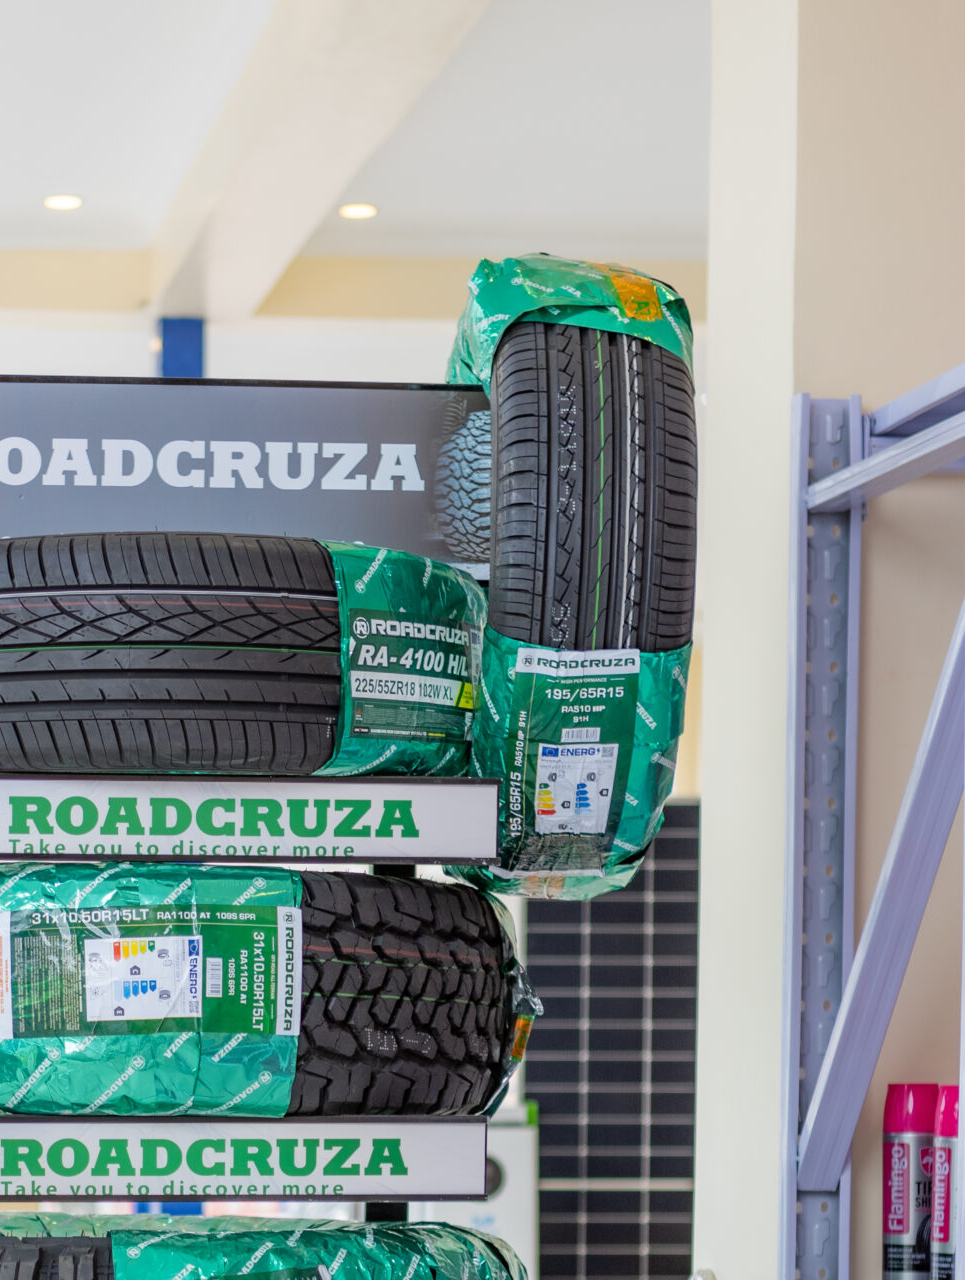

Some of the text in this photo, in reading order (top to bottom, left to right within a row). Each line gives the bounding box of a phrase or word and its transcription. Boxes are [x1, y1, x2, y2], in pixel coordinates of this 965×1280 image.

[371, 618, 469, 646] ROADCRUZA
[537, 657, 636, 669] ROADCRUZA
[355, 678, 416, 697] 225/55ZR18
[419, 682, 442, 699] 102W
[443, 684, 454, 700] XL
[545, 686, 625, 702] 195/65R15
[519, 711, 527, 727] 91H
[561, 705, 591, 713] RA510
[573, 715, 589, 723] 91H
[515, 741, 524, 767] RA510
[560, 747, 596, 757] ENERG
[8, 795, 420, 838] ROADCRUZA
[510, 771, 524, 838] 195/65R15
[9, 839, 62, 854] Take
[135, 842, 159, 856] to
[171, 839, 280, 856] discover
[293, 845, 354, 857] more
[32, 908, 149, 925] 31x10.50R15LT
[156, 910, 197, 920] RA1100
[200, 911, 211, 919] AT
[239, 913, 256, 921] 6PR
[240, 949, 248, 991] RA1100
[252, 931, 265, 1031] 31x10.50R15LT
[283, 927, 295, 1032] ROADCRUZA
[5, 1059, 52, 1109] ROADCRUZA
[0, 1138, 408, 1177] ROADCRUZA
[1, 1181, 54, 1195] Take
[126, 1183, 151, 1195] to
[163, 1180, 270, 1195] discover
[282, 1184, 344, 1195] more
[888, 1145, 909, 1231] Flamingo
[932, 1150, 950, 1239] Flamingo
